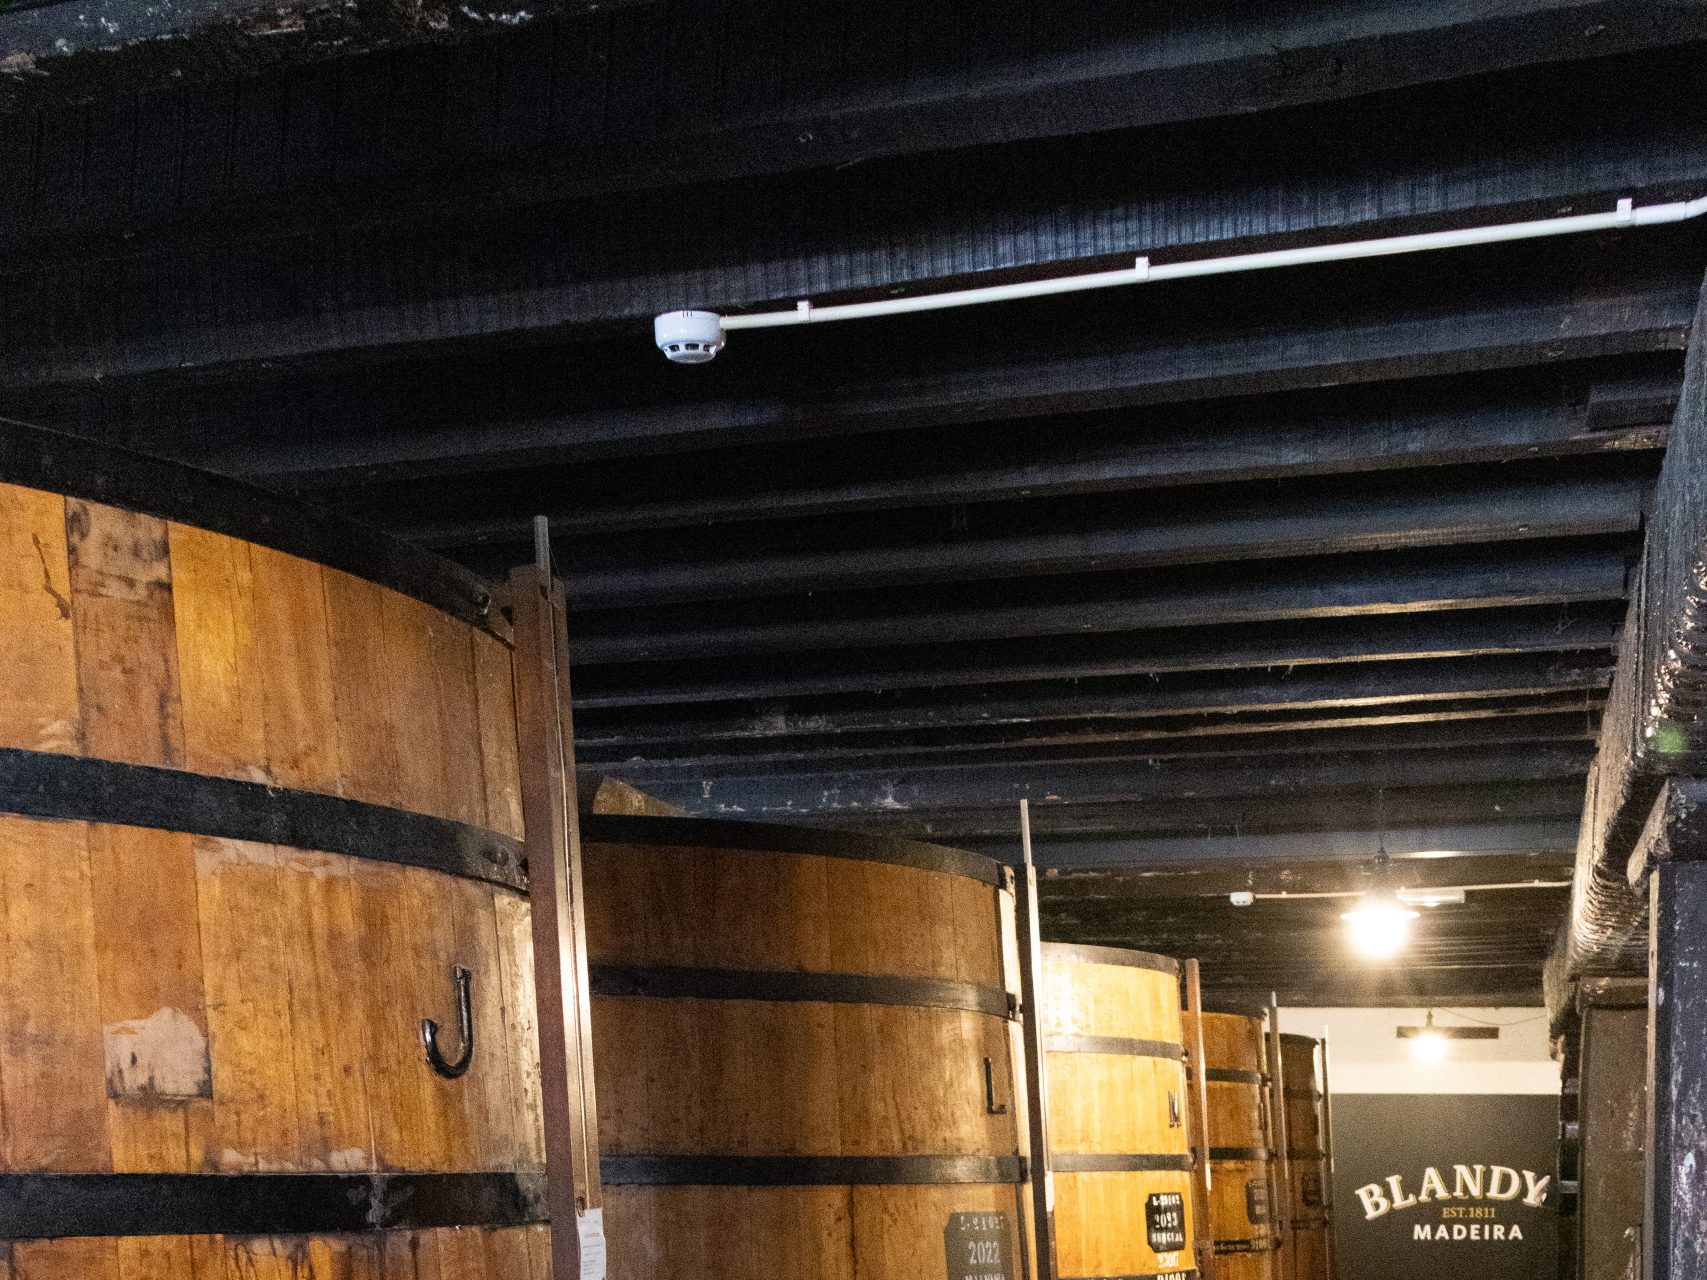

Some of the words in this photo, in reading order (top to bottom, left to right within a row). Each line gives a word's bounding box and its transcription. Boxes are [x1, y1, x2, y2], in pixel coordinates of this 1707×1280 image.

[1355, 1164, 1551, 1221] BLANDY
[1413, 1224, 1523, 1240] MADEIRA
[968, 1241, 1000, 1265] 2022
